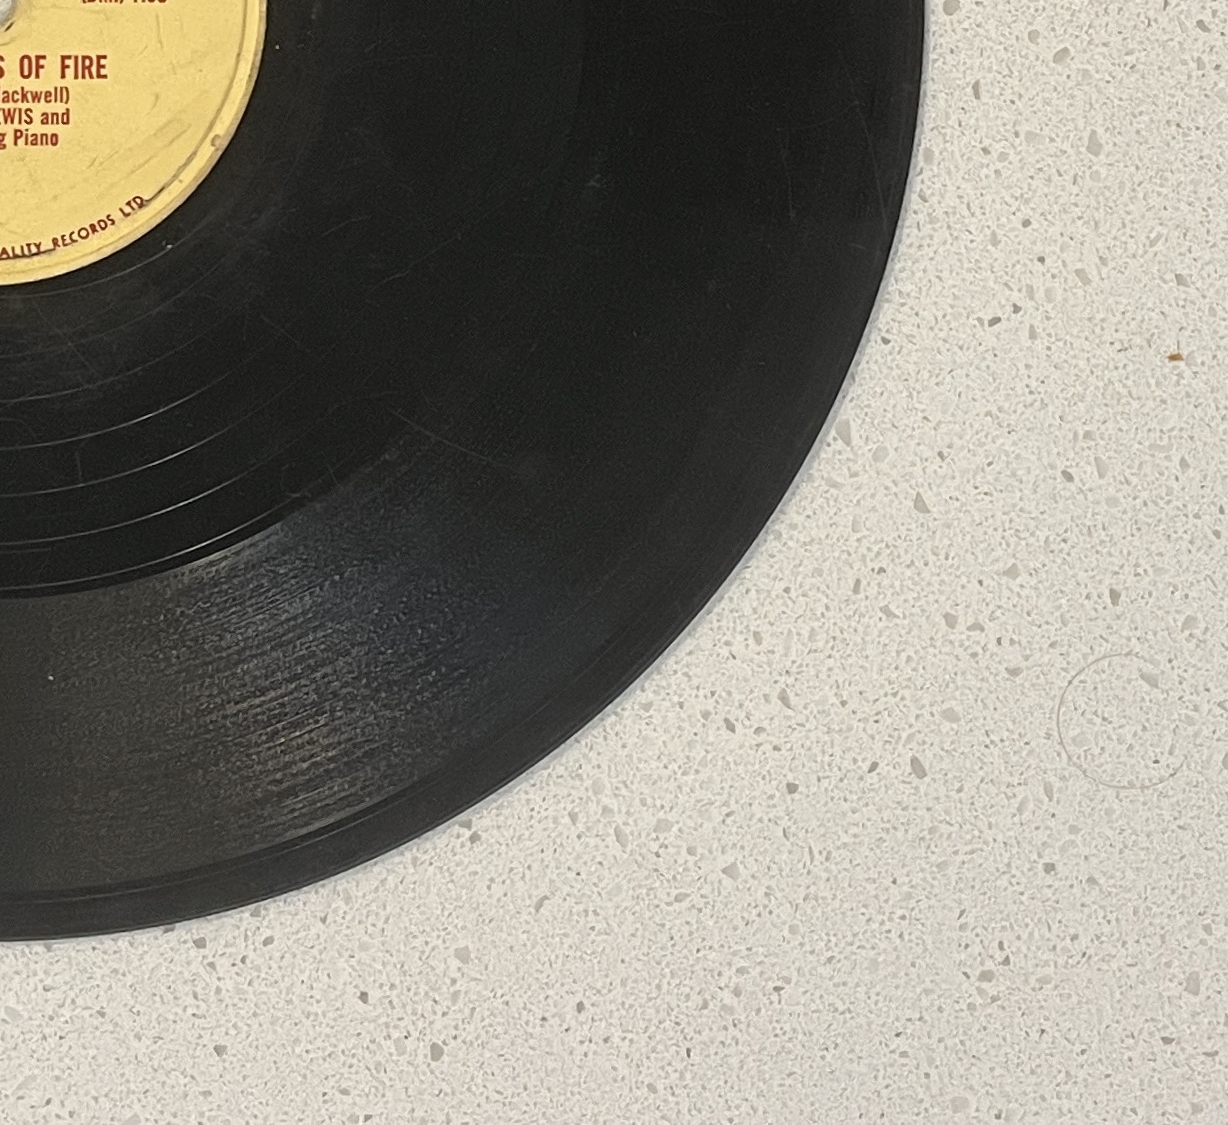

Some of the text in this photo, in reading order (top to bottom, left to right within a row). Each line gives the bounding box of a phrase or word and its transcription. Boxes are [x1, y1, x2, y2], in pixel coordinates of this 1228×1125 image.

[18, 54, 47, 80] OF
[60, 54, 108, 80] FIRE
[40, 107, 71, 126] and
[13, 128, 59, 147] Piano
[52, 214, 116, 249] RECORDS
